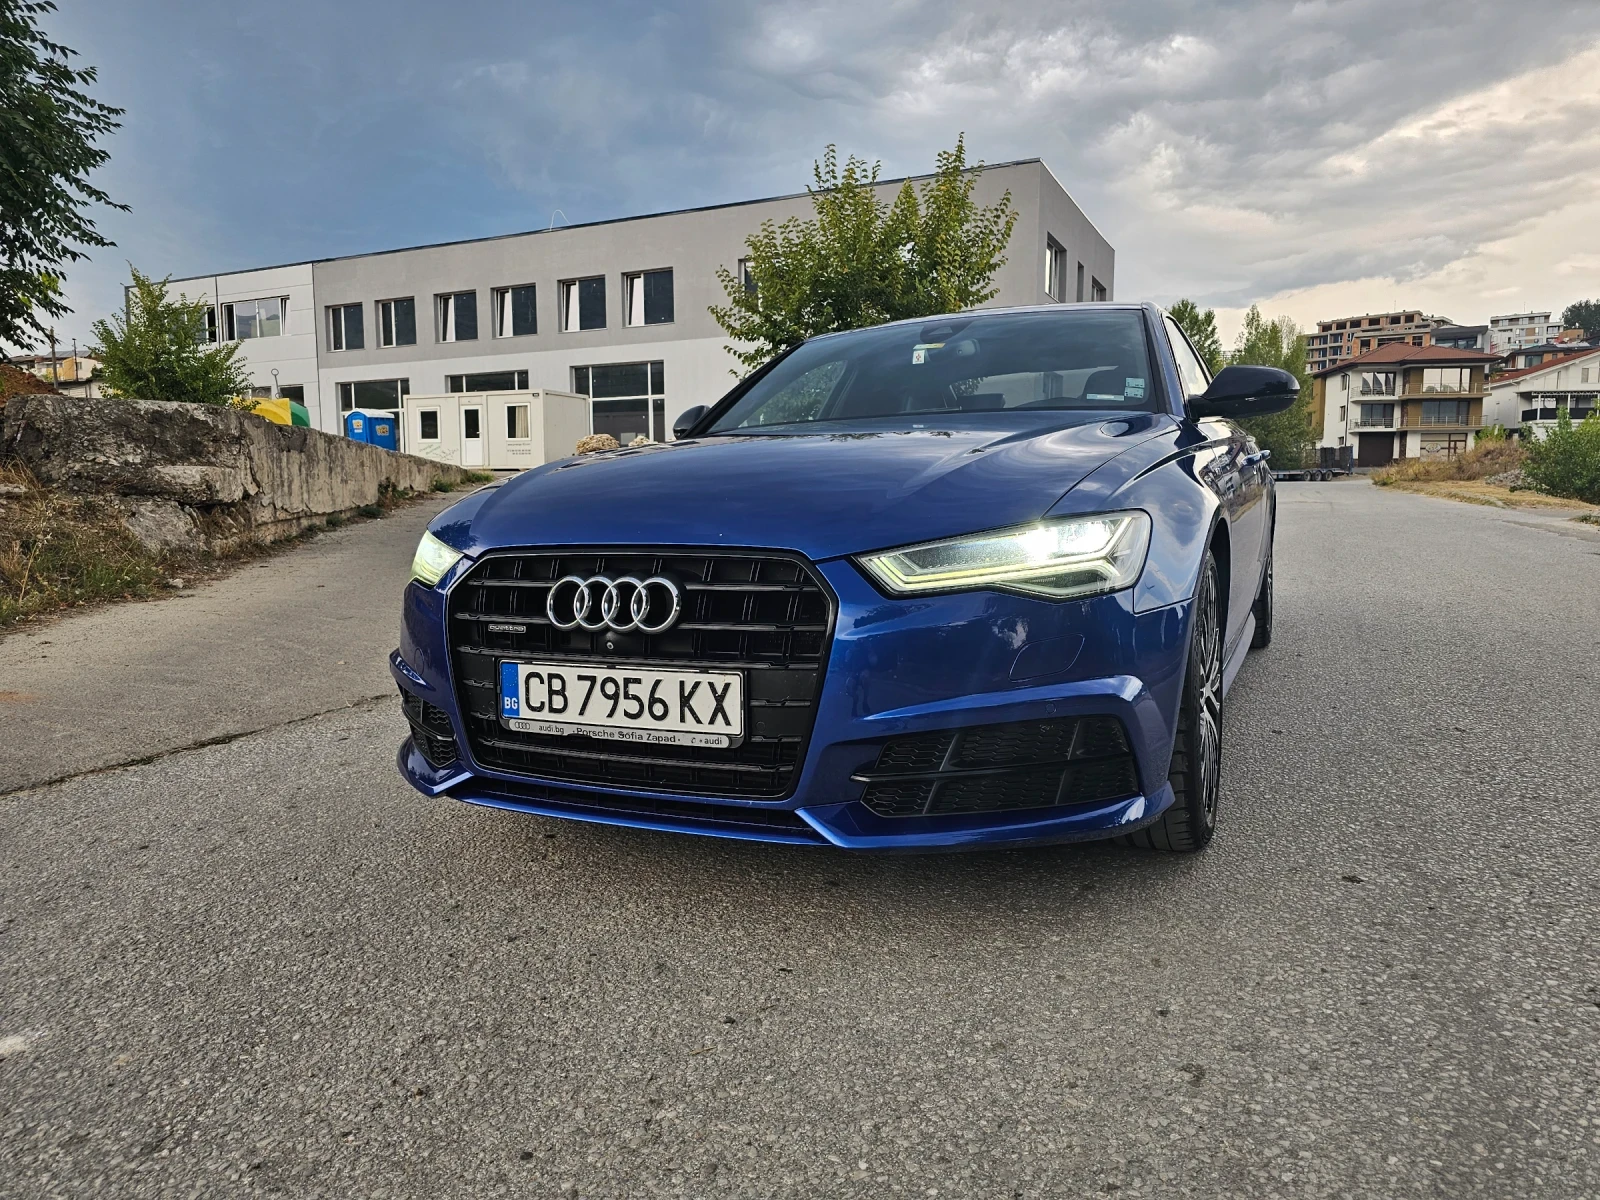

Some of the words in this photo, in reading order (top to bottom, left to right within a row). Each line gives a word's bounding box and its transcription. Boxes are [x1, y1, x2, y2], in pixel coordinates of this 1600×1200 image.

[504, 696, 518, 710] BG
[524, 671, 568, 714] CB
[577, 674, 669, 721] 7956
[679, 680, 732, 727] KX
[538, 724, 565, 735] audi.bg
[576, 728, 615, 738] Porsche
[617, 731, 644, 741] Sofia
[646, 733, 676, 744] Zapad
